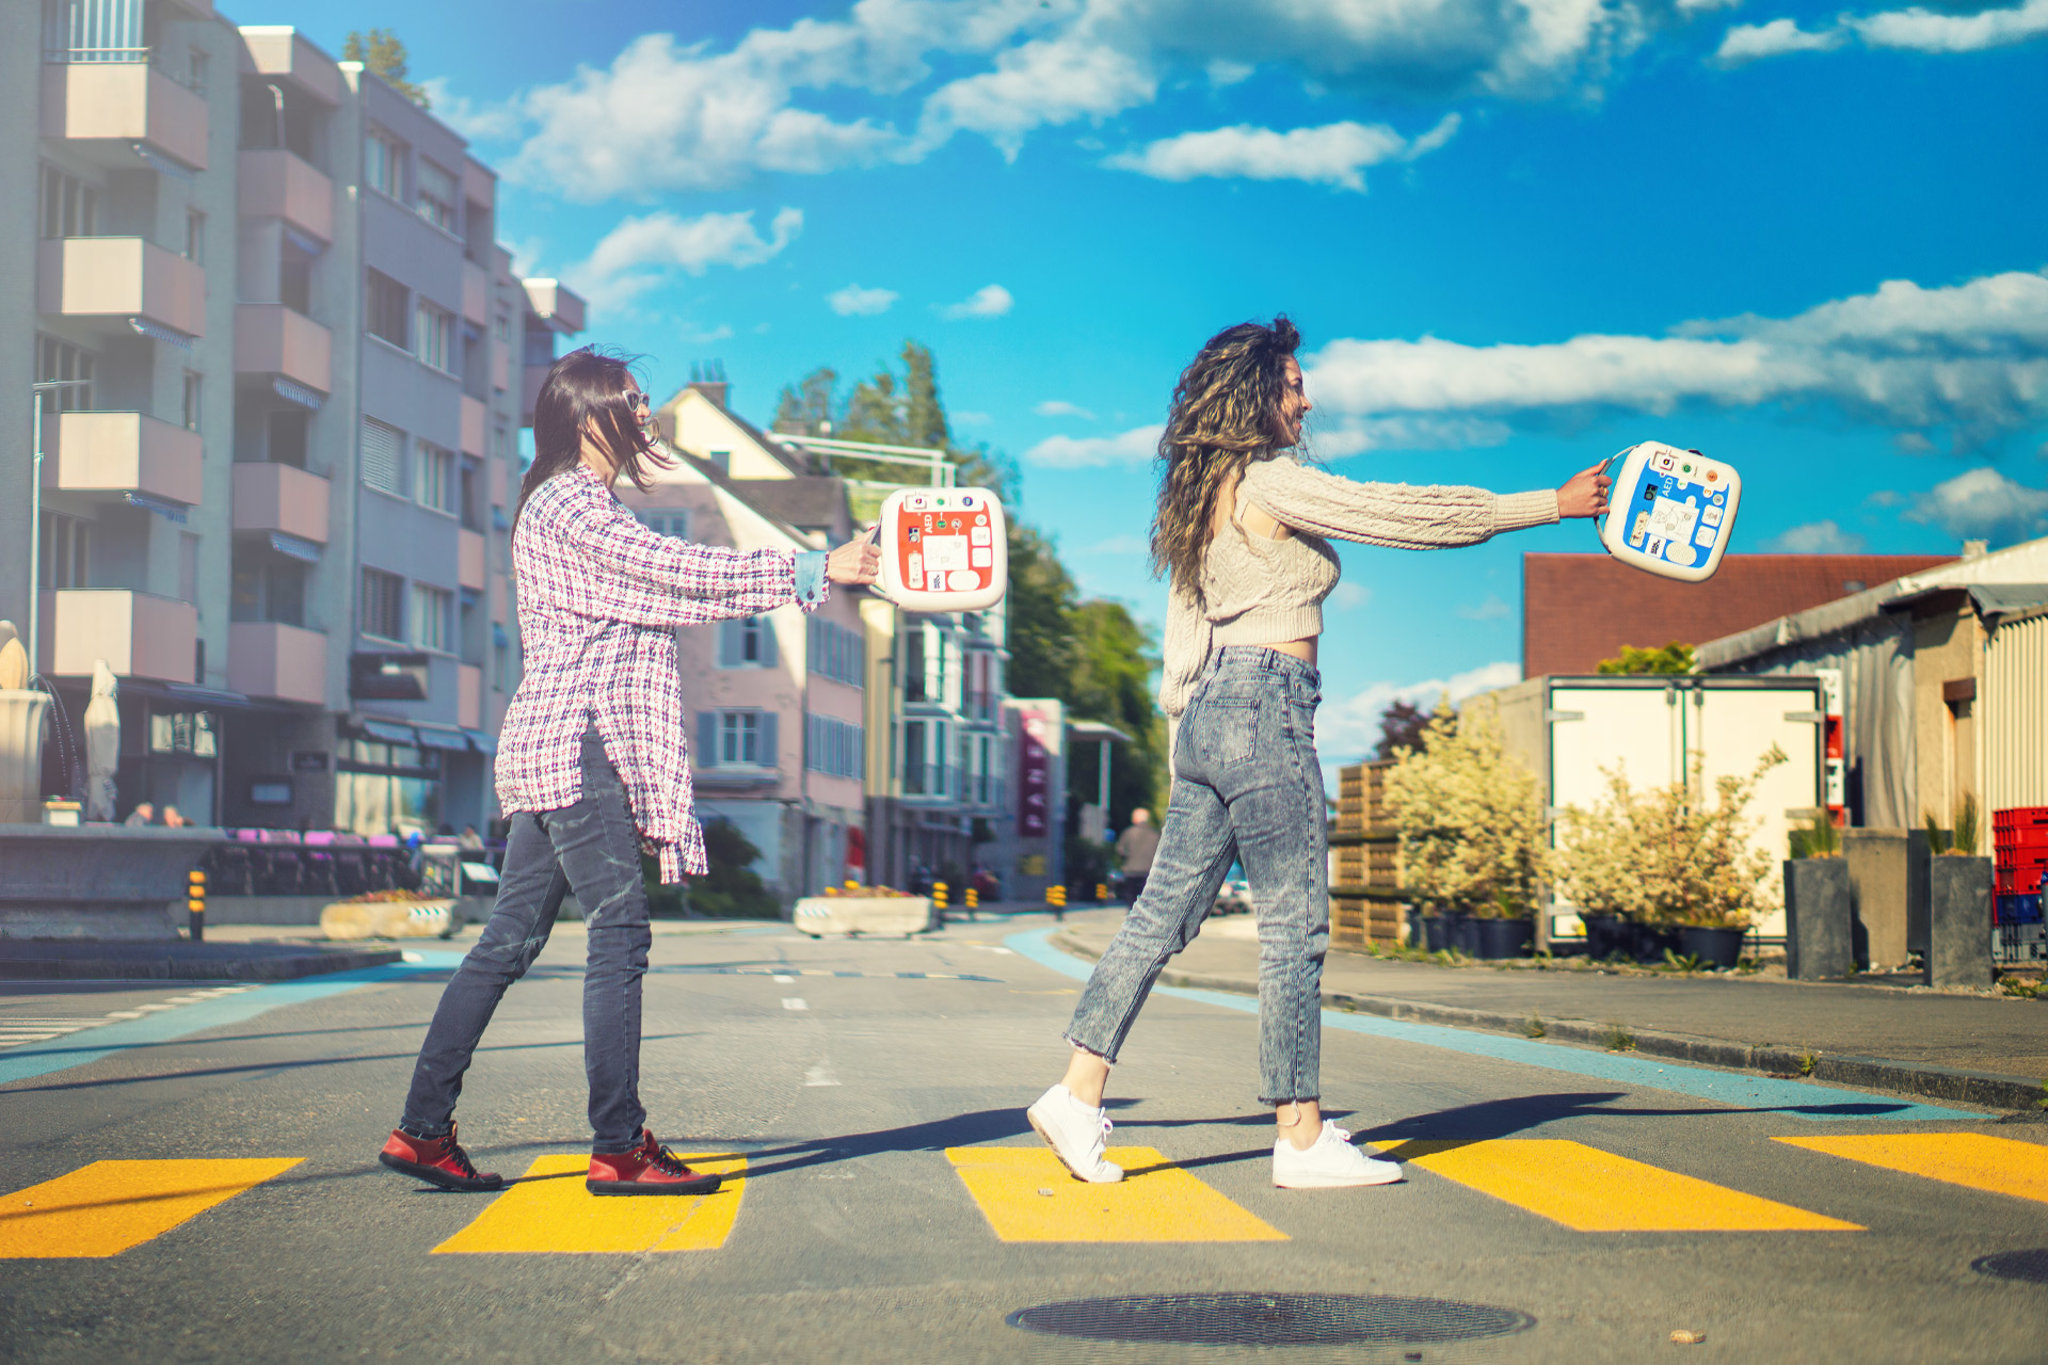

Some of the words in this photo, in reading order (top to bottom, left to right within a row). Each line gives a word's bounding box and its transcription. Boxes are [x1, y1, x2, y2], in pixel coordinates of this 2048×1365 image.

[1662, 477, 1673, 497] AED
[1704, 488, 1712, 496] 3
[924, 514, 933, 534] AED
